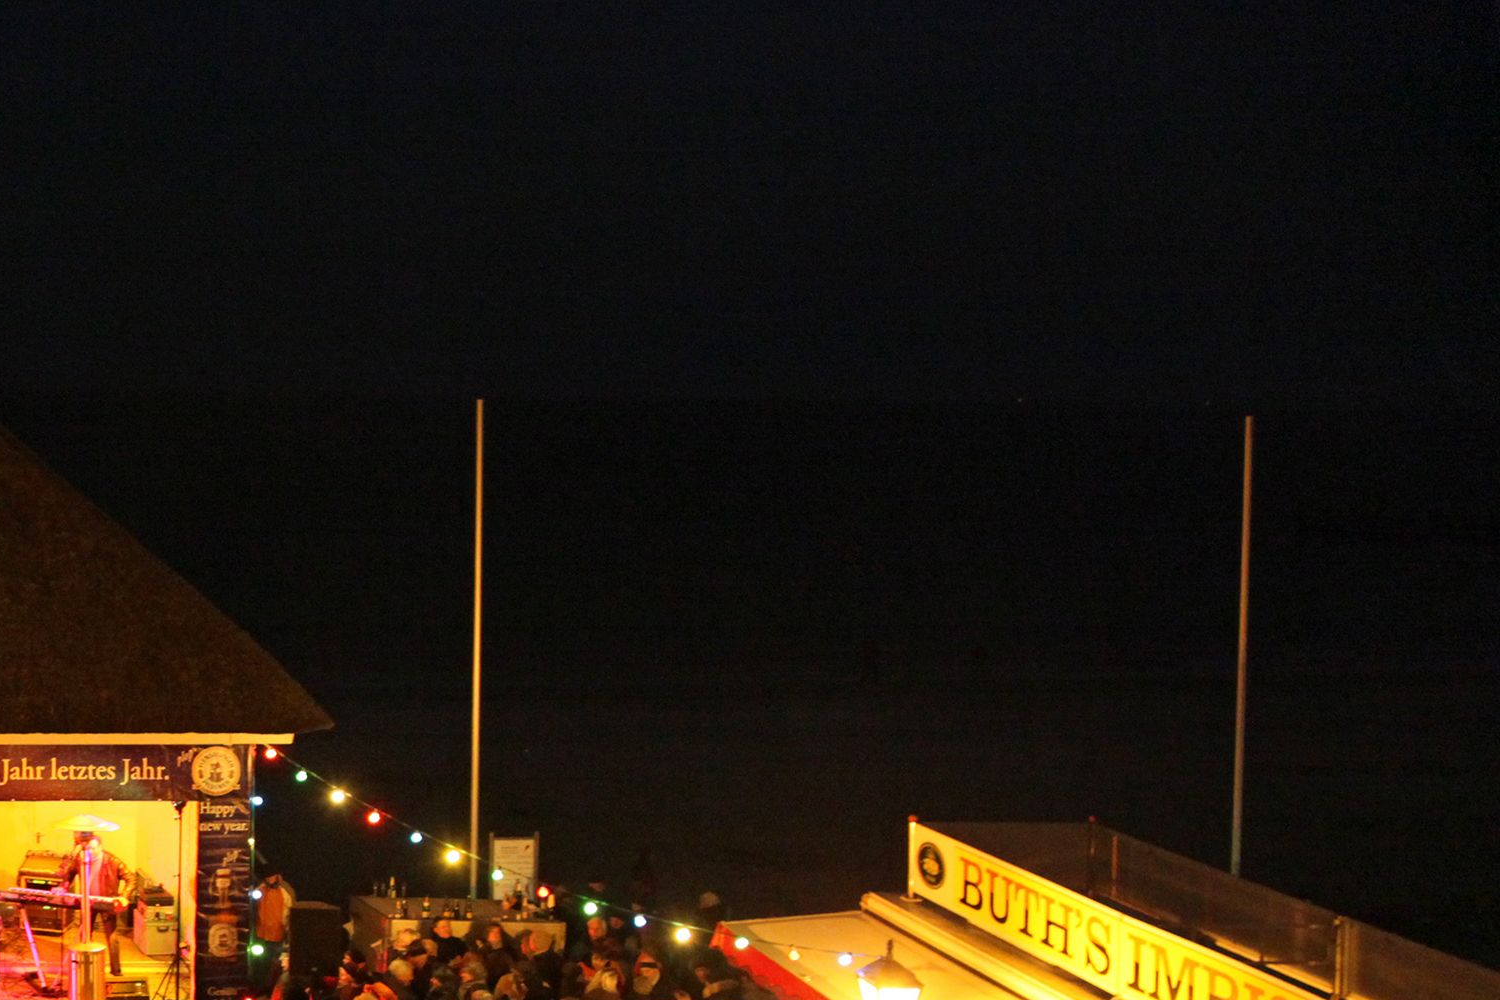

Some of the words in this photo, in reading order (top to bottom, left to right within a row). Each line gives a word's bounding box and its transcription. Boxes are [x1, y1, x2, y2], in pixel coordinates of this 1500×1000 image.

[0, 758, 46, 785] Jahr
[50, 758, 116, 782] letztes
[119, 758, 170, 785] Jahr.
[200, 801, 236, 817] Happy
[200, 822, 222, 831] new
[223, 822, 248, 835] year.
[959, 857, 1110, 976] BUTH'S
